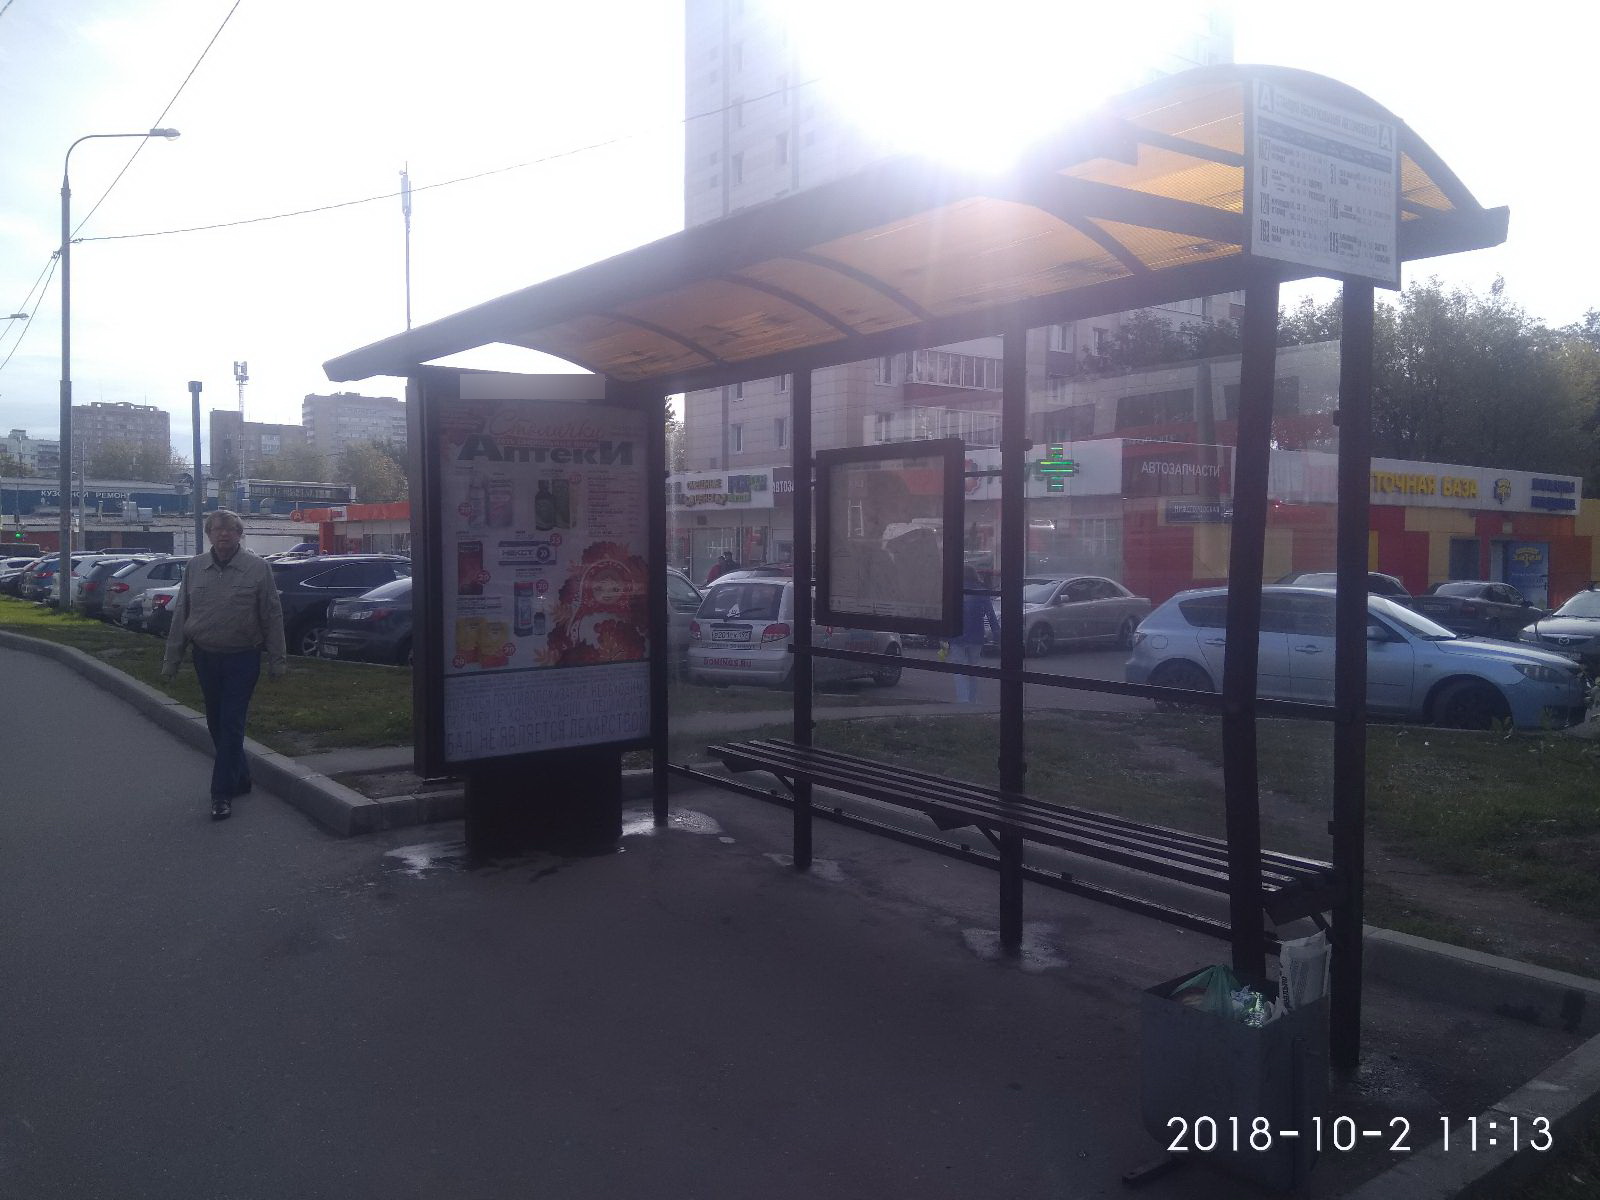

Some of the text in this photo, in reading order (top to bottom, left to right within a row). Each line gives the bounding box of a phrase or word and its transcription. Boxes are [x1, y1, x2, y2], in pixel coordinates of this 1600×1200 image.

[1141, 461, 1220, 478] АВТОЗАПЧАСТИ
[1441, 476, 1479, 498] БАЗА
[447, 711, 650, 756] БАД НЕ ЯВЛЯЕТСЯ ЛЕКАРСТВОМ
